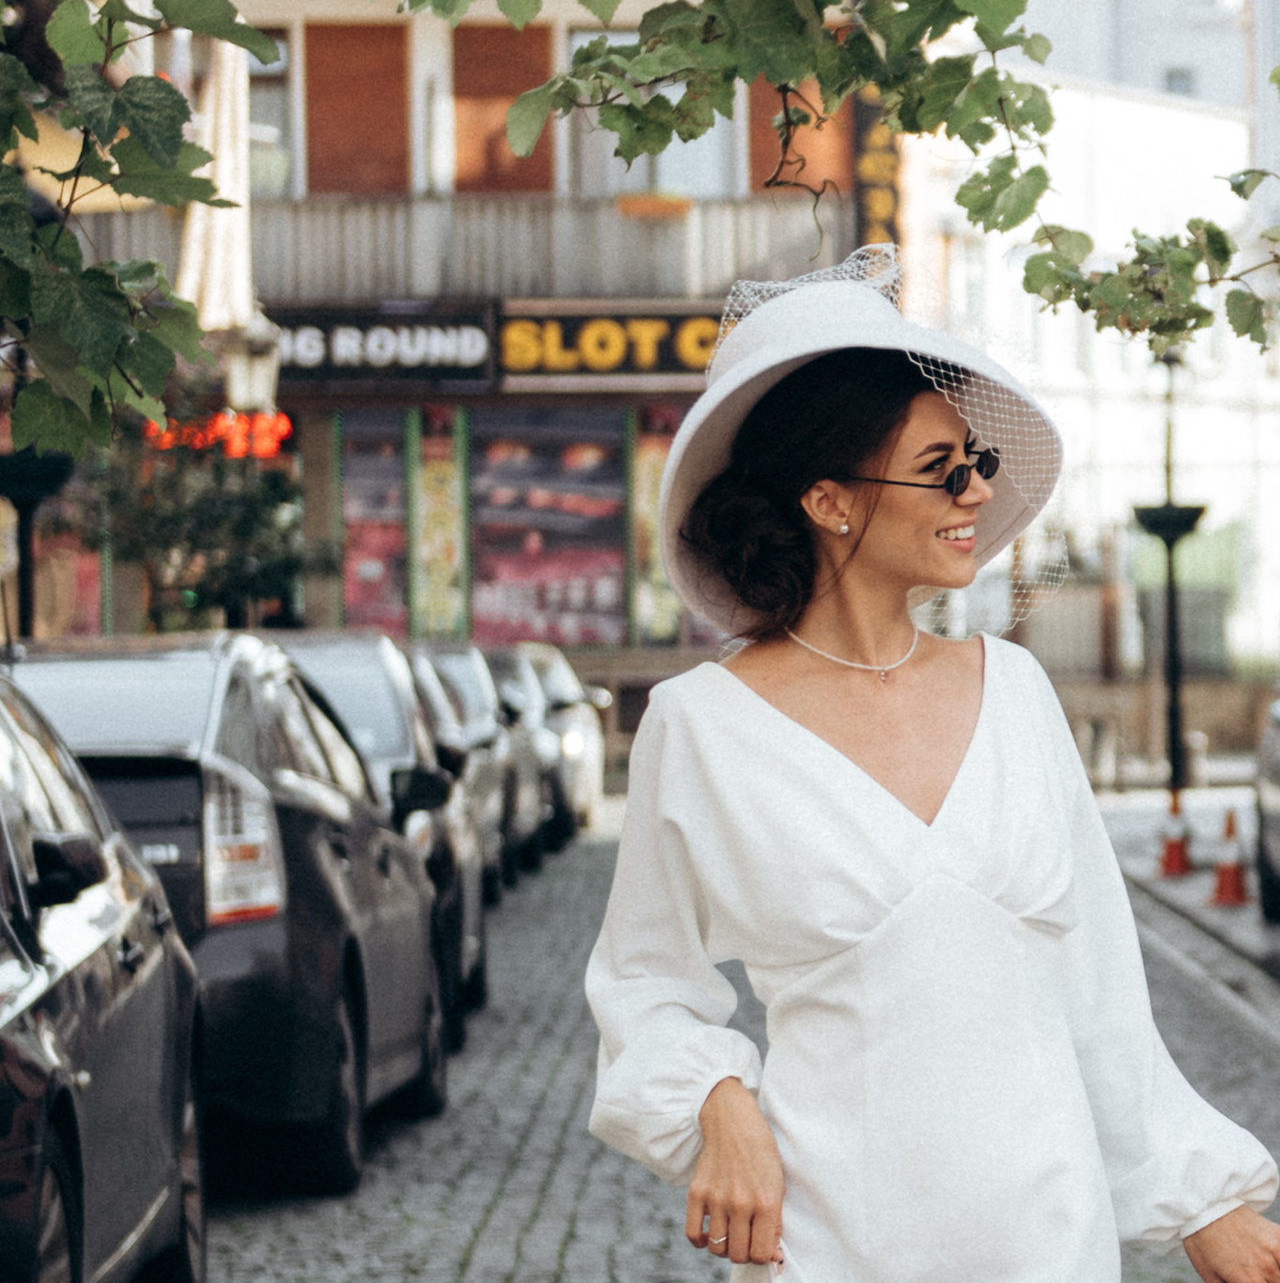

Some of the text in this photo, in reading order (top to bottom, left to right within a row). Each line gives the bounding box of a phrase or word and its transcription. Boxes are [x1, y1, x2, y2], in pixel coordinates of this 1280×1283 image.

[332, 325, 488, 367] ROUND
[502, 318, 737, 370] SLOT C
